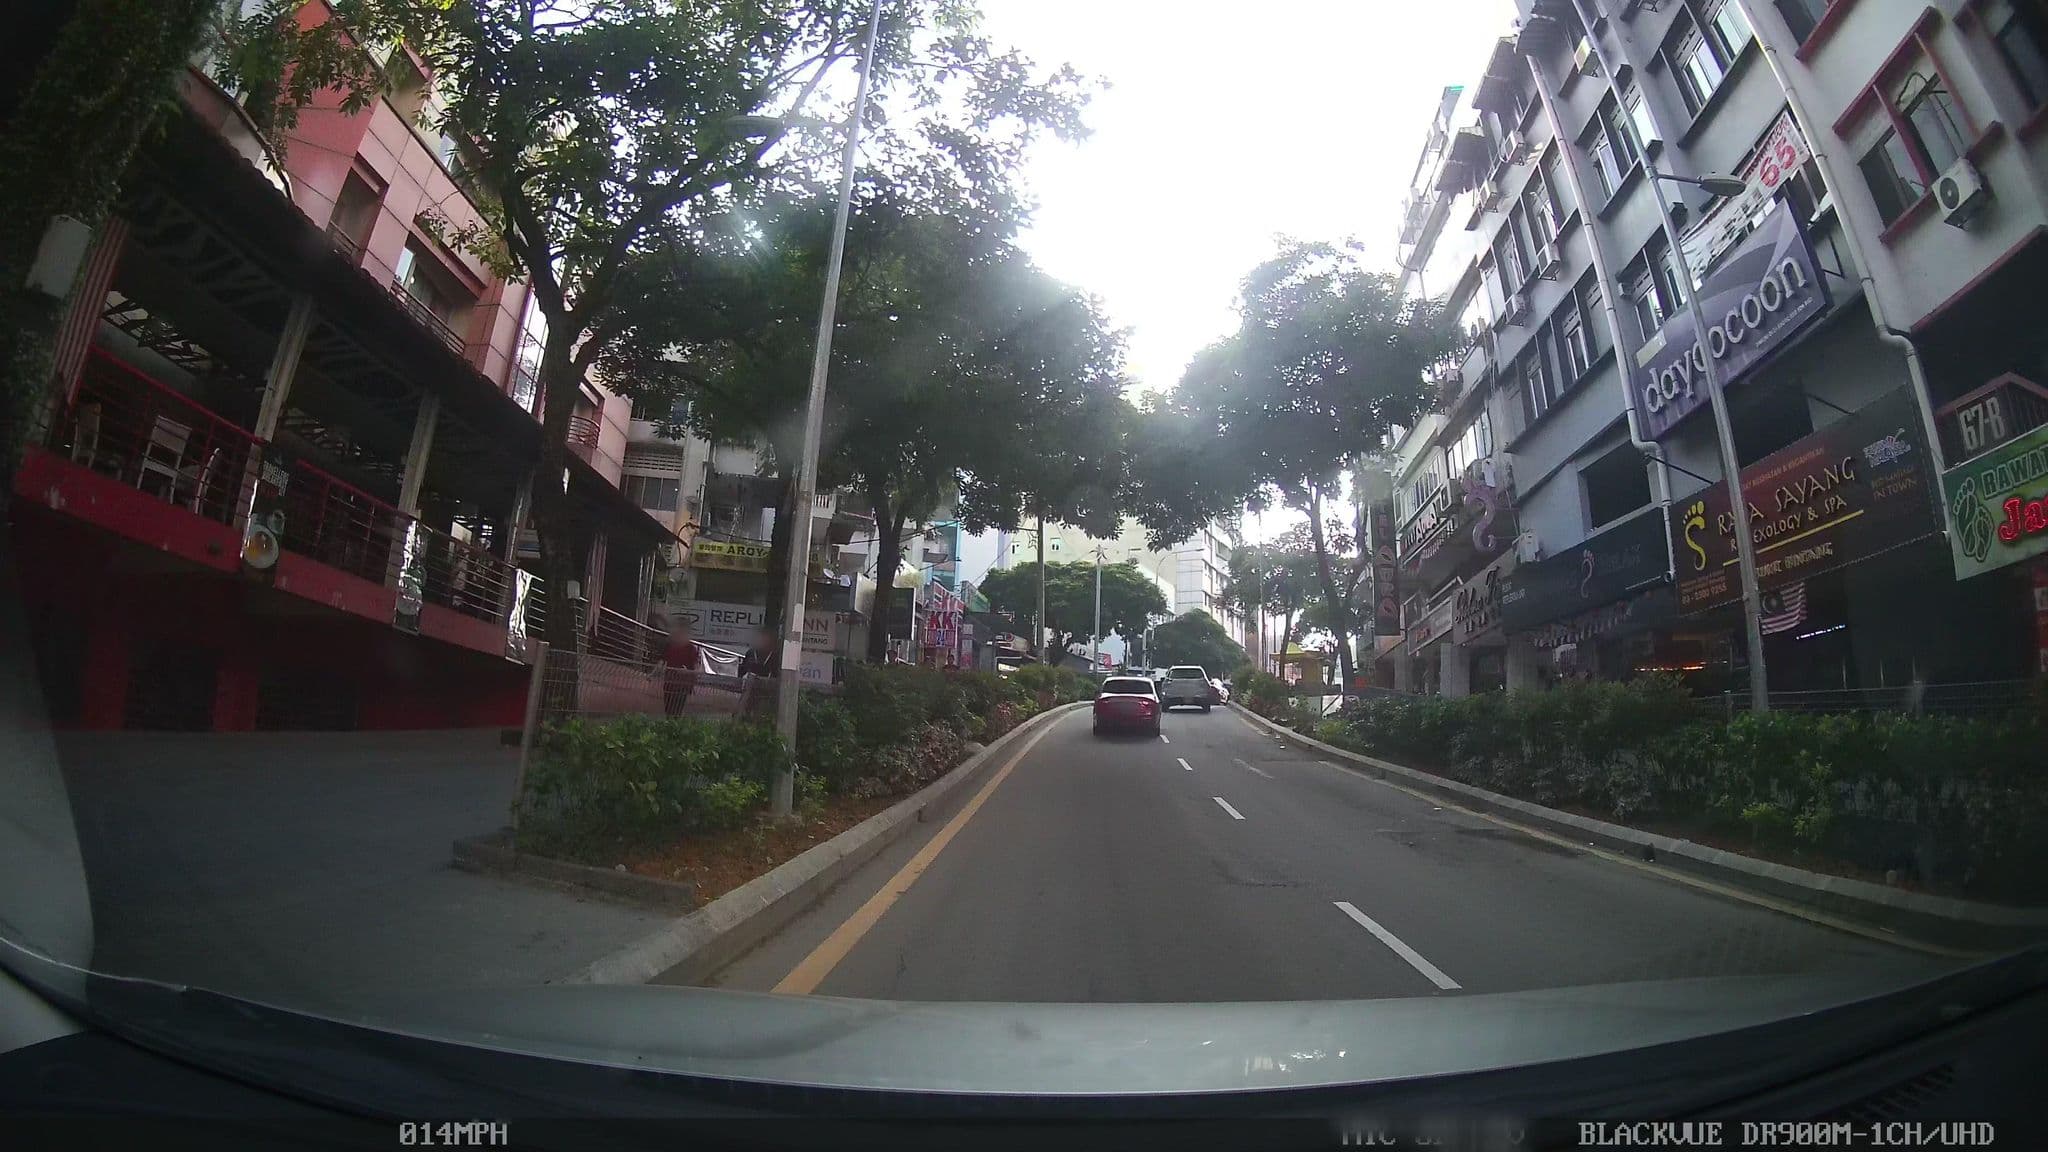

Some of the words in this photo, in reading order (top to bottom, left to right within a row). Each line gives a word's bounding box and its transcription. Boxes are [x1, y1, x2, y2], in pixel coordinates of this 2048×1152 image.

[1758, 136, 1798, 188] 65
[1718, 503, 1764, 536] RAA
[1775, 456, 1857, 512] SAYANG
[1730, 513, 1803, 552] REXOLOGY
[1807, 507, 1819, 522] &
[1824, 494, 1848, 515] SPA
[711, 609, 766, 625] REPLI
[803, 617, 828, 632] NN
